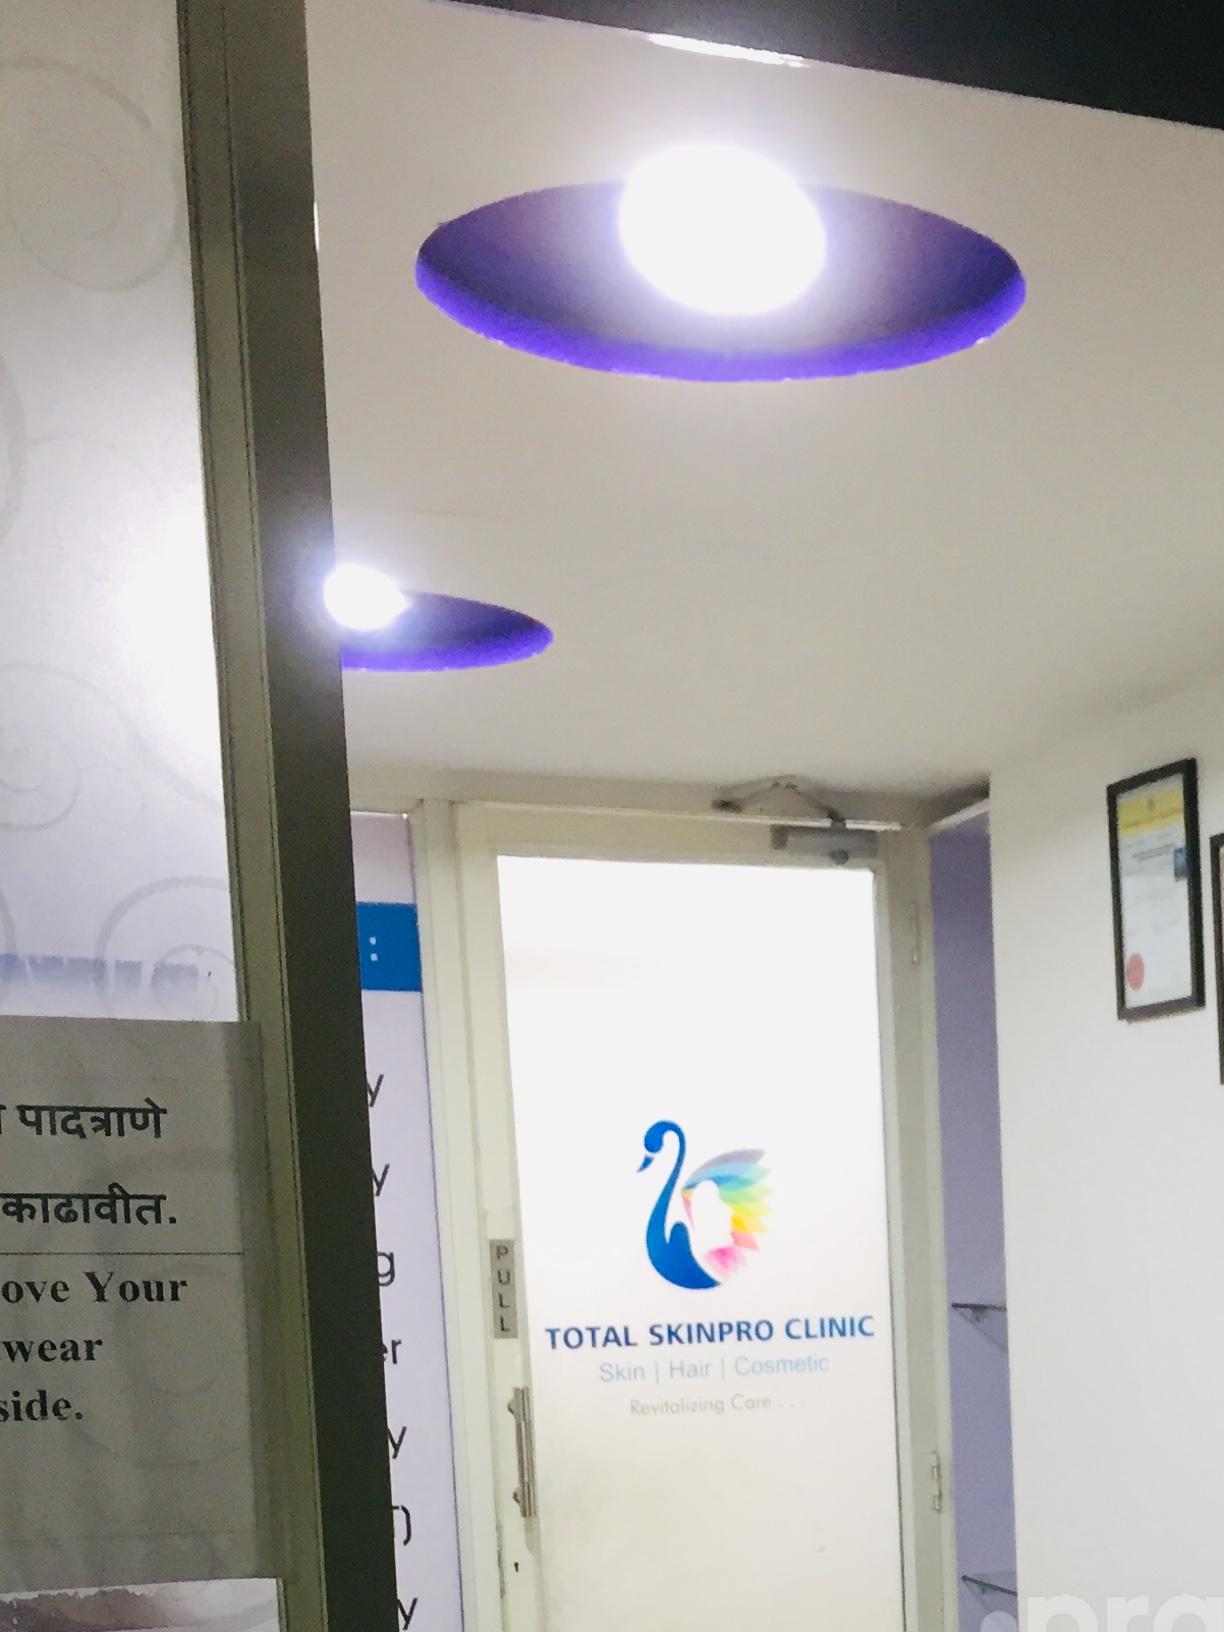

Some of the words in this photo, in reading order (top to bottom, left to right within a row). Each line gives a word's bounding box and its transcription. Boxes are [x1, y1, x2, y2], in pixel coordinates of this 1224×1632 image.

[16, 1097, 168, 1139] पादत्राणे
[0, 1182, 177, 1226] काढावीत.
[84, 1271, 188, 1302] Your
[494, 1245, 513, 1334] PULL
[545, 1325, 639, 1350] TOTAL
[649, 1319, 775, 1347] SKINPRO
[785, 1314, 876, 1341] CLINIC
[599, 1361, 647, 1383] Skin
[669, 1358, 712, 1380] Hair
[734, 1353, 831, 1377] Cosmetic
[630, 1396, 727, 1416] Revitalizing
[730, 1392, 773, 1410] Care
